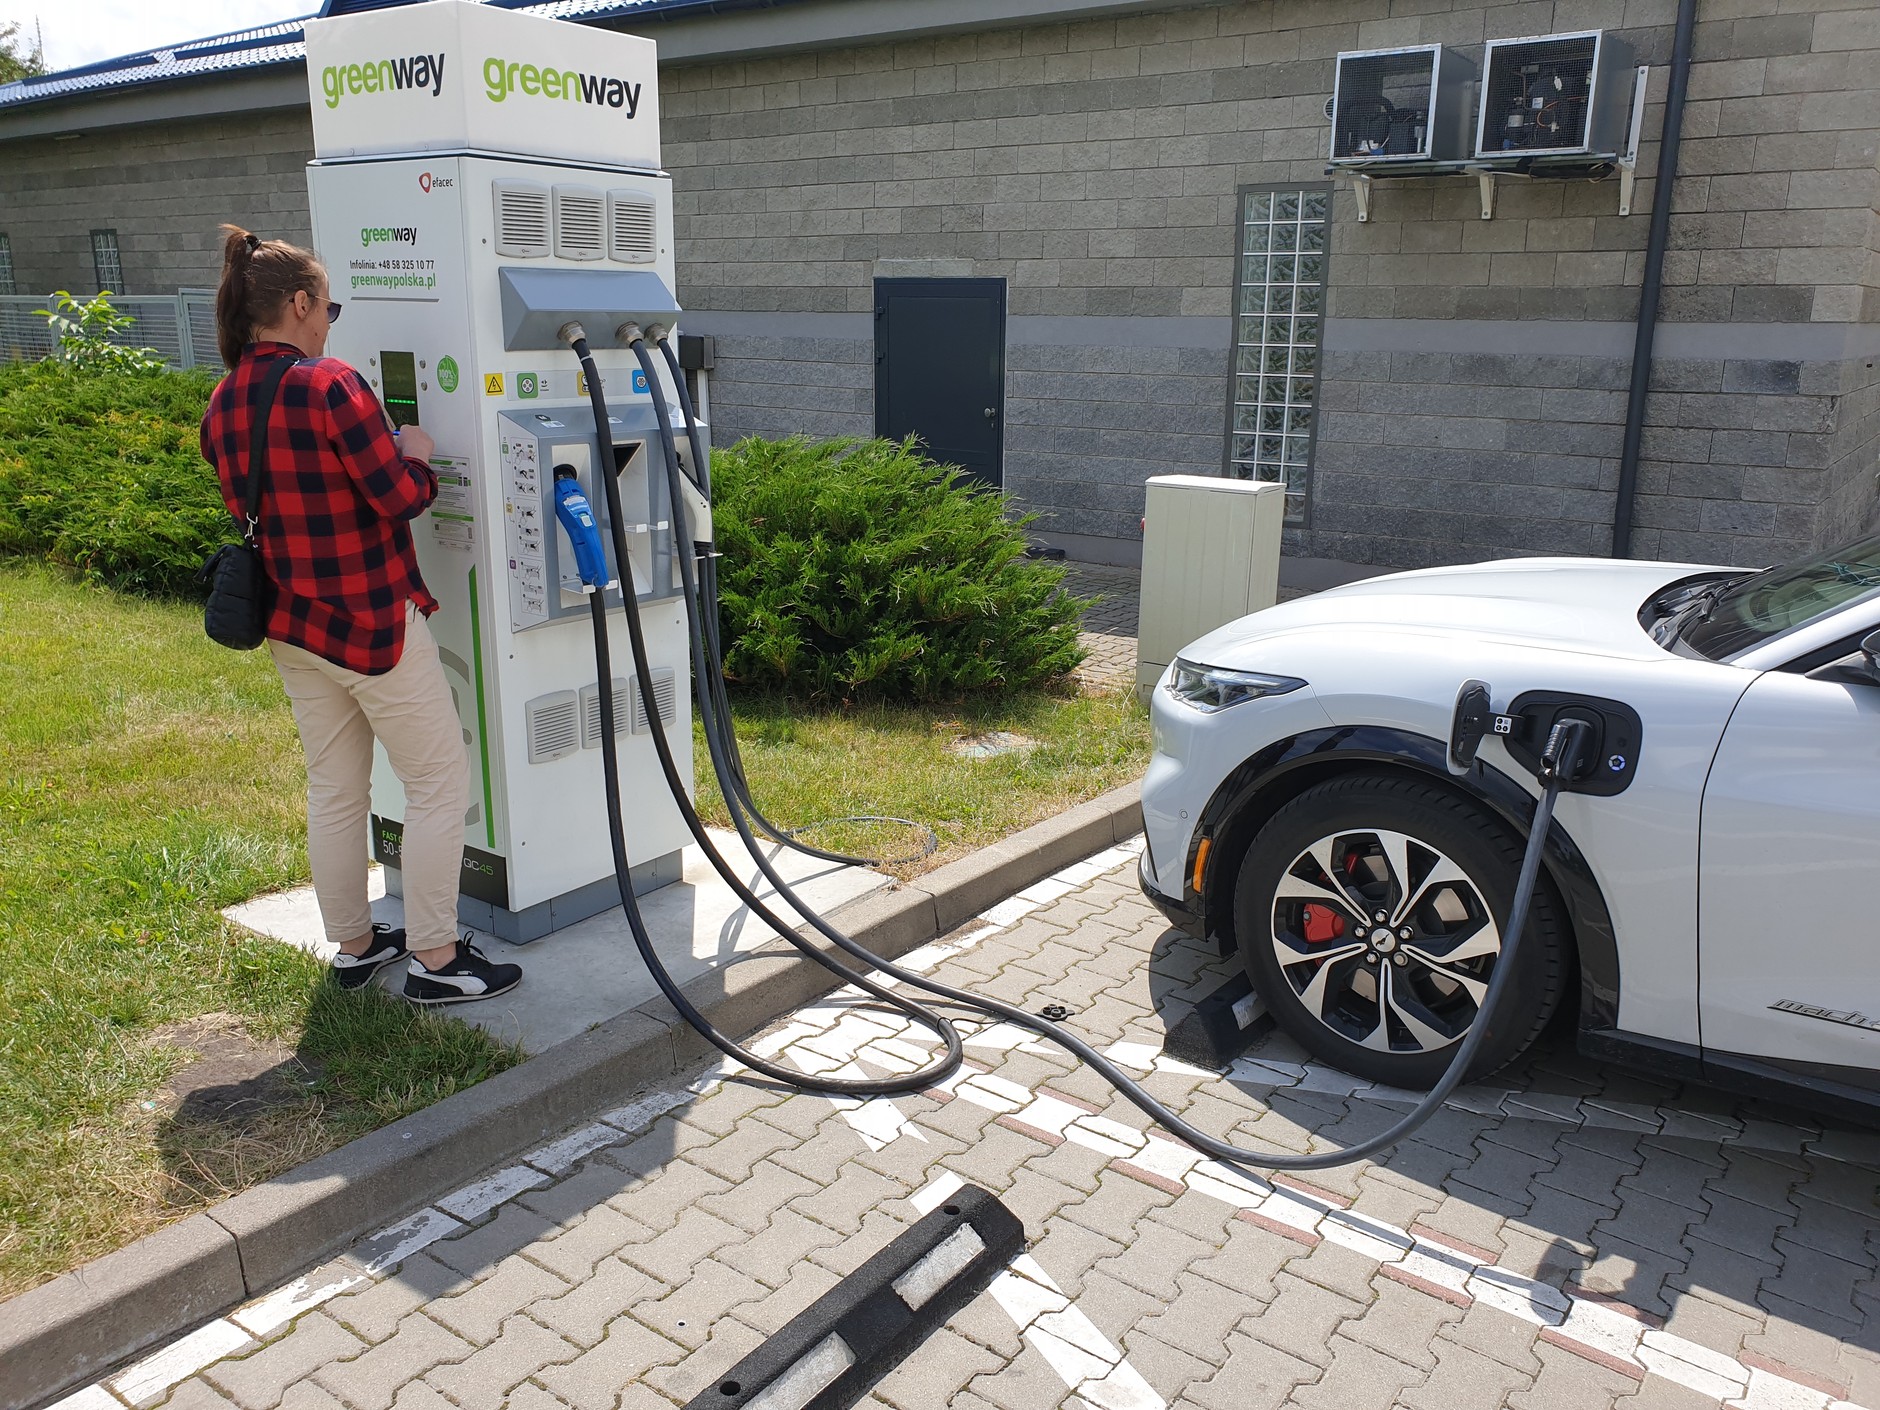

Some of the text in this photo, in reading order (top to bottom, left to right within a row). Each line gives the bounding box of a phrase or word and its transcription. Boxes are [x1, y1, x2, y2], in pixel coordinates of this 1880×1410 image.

[322, 53, 445, 109] greenway
[483, 57, 641, 119] greenway
[432, 176, 453, 188] efacec
[361, 227, 417, 247] greenway
[350, 259, 435, 270] Infolinia: +48 58 325 10 77
[351, 272, 436, 290] greenwaypolska.pl
[382, 830, 397, 842] FAST
[463, 858, 494, 876] QC45
